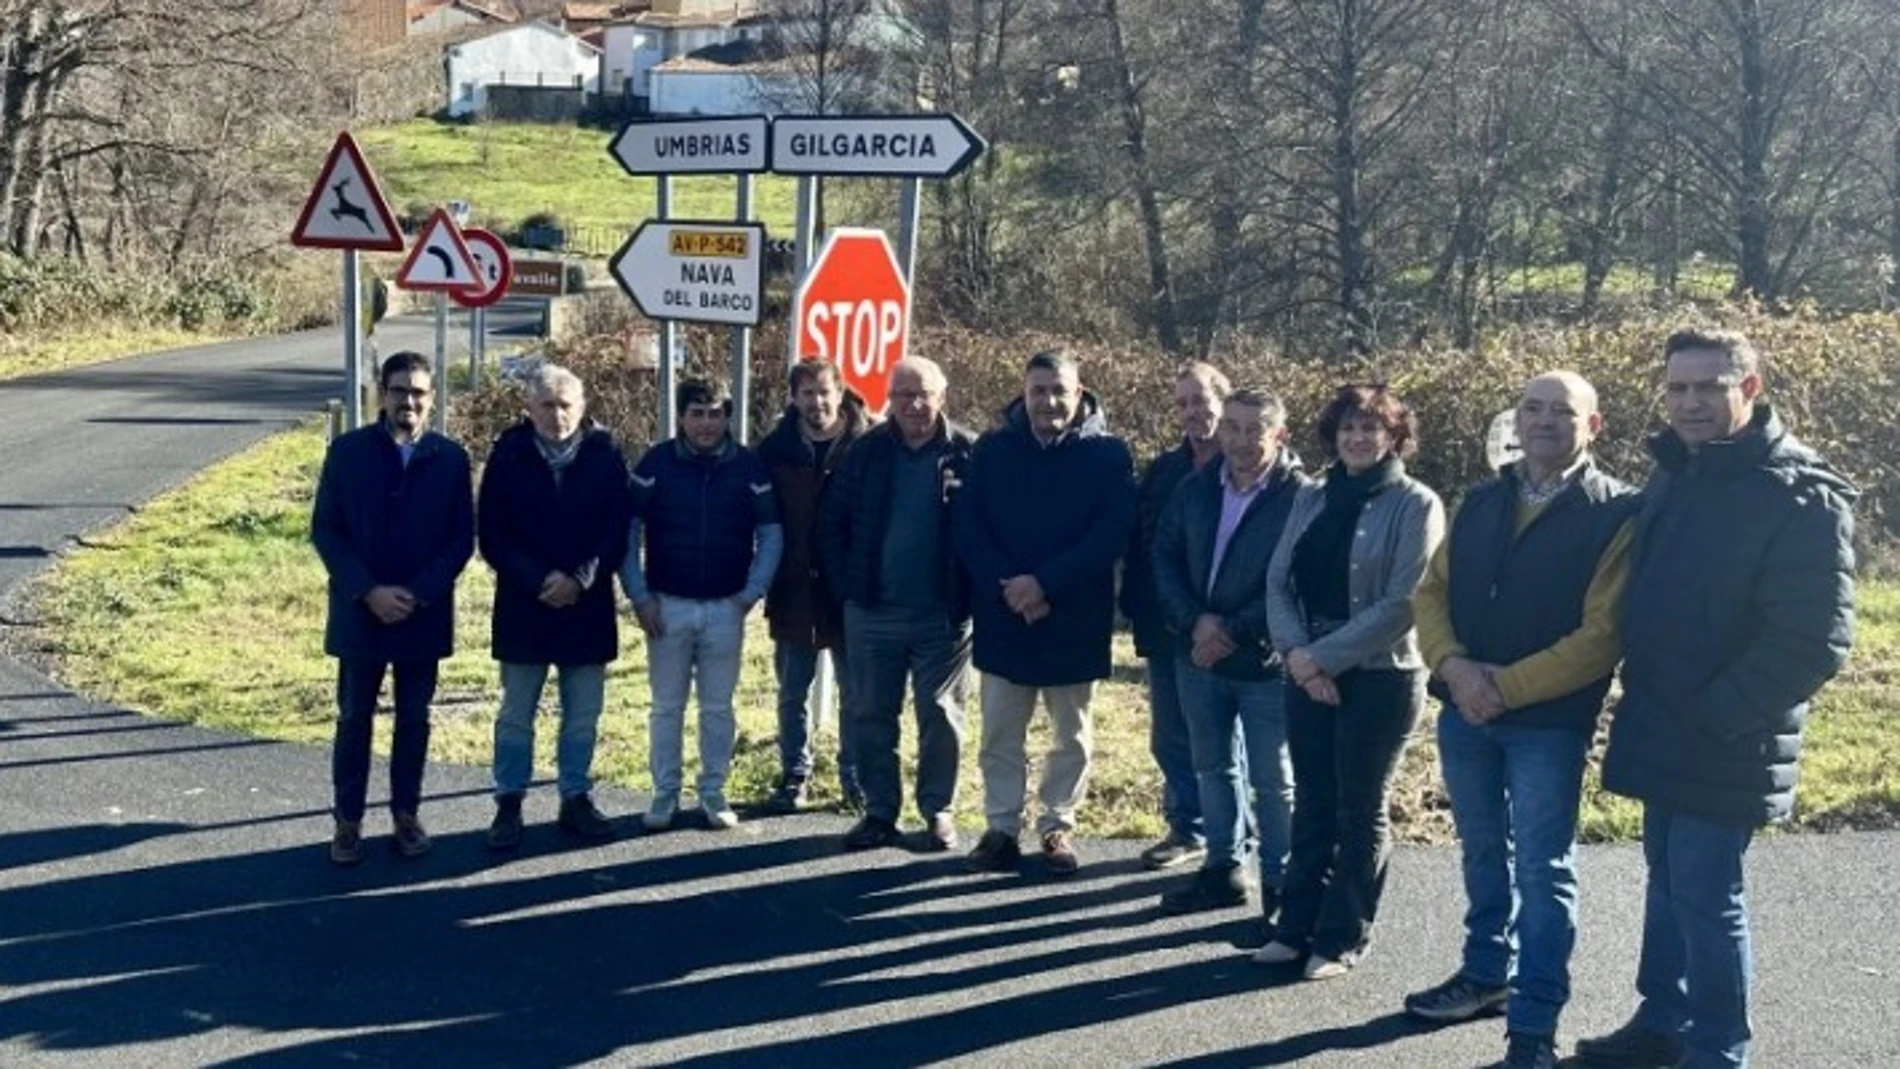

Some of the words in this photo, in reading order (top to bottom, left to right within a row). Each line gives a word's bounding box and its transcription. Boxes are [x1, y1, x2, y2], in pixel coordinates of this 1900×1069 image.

[654, 132, 751, 158] UMBRIAS
[790, 132, 937, 158] GILGARCIA
[681, 263, 736, 286] NAVA
[663, 289, 692, 307] DEL
[700, 291, 752, 311] BARCO
[806, 298, 901, 377] STOP
